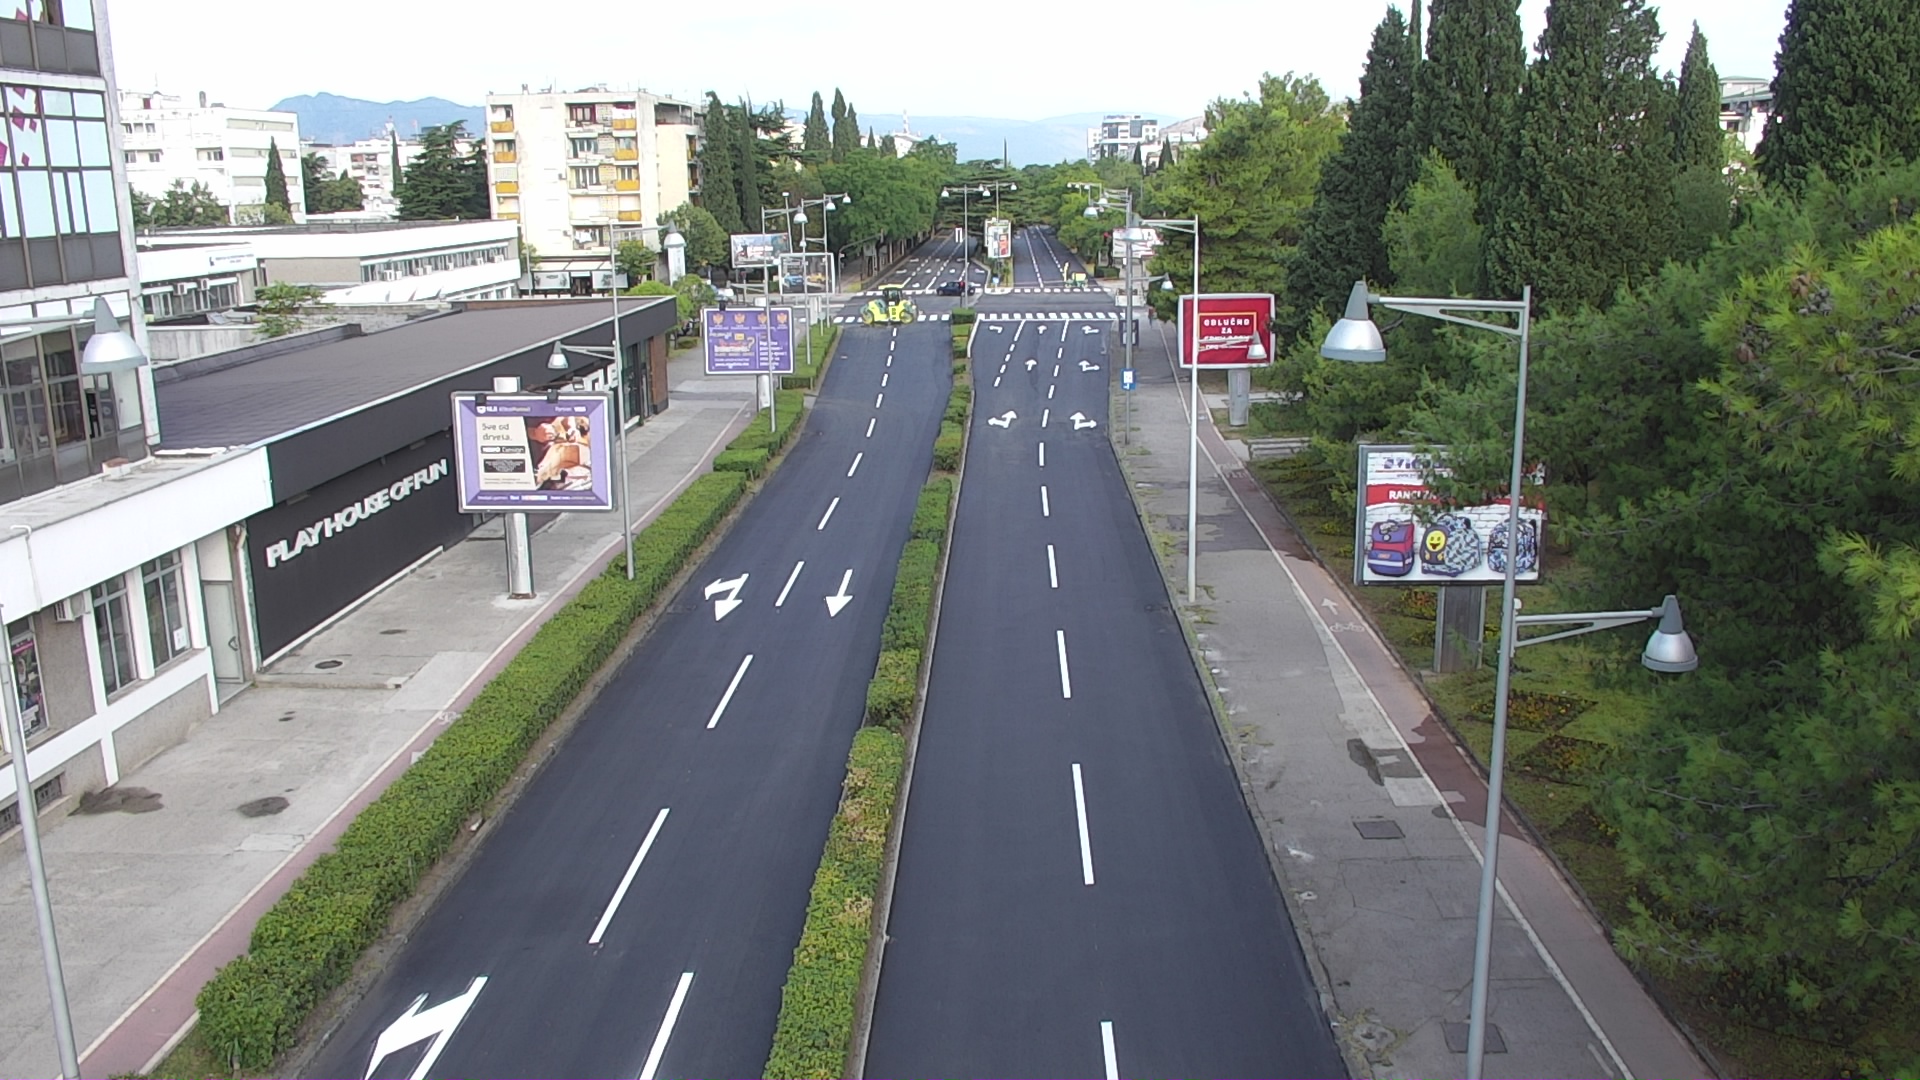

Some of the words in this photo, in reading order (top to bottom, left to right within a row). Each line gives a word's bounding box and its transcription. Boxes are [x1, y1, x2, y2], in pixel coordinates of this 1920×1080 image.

[1203, 317, 1250, 326] ODLUČNO
[482, 423, 496, 431] Sve
[414, 459, 448, 490] FUN
